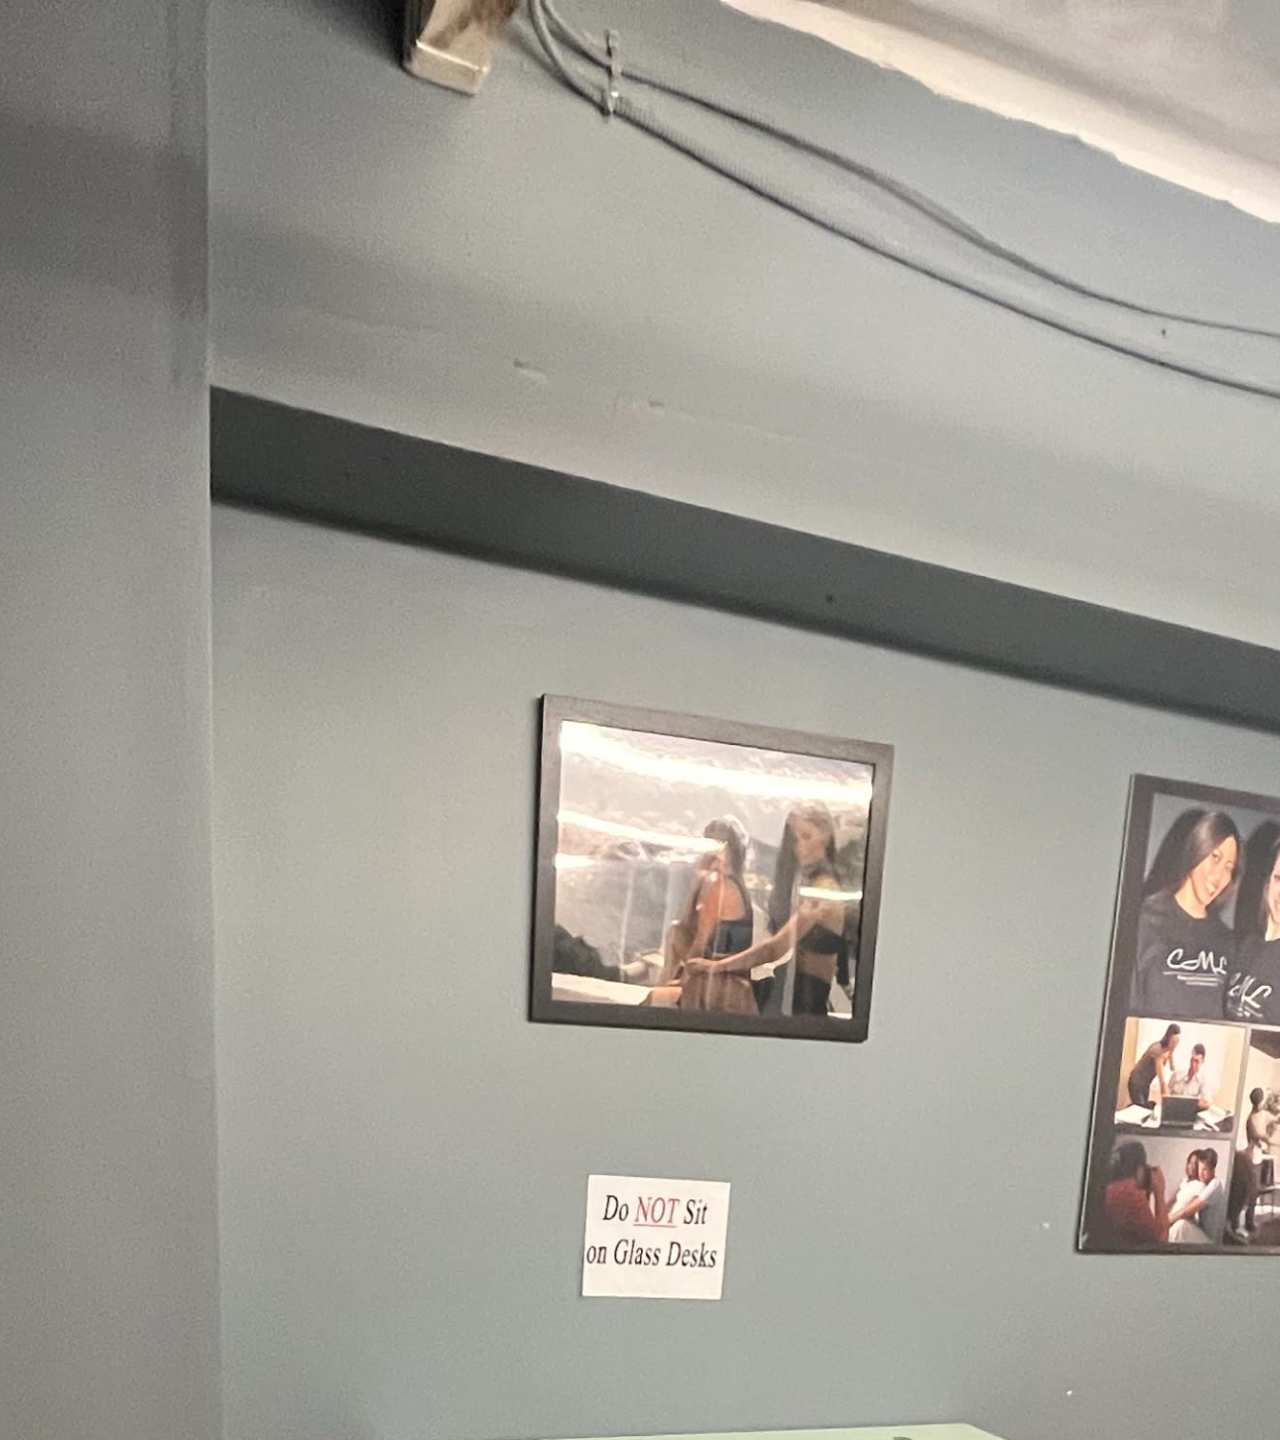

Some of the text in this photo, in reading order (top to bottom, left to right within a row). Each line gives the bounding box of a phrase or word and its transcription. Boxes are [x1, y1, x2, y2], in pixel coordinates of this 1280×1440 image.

[602, 1195, 708, 1225] Do NOT Sit
[586, 1239, 718, 1268] on Glass Desks
